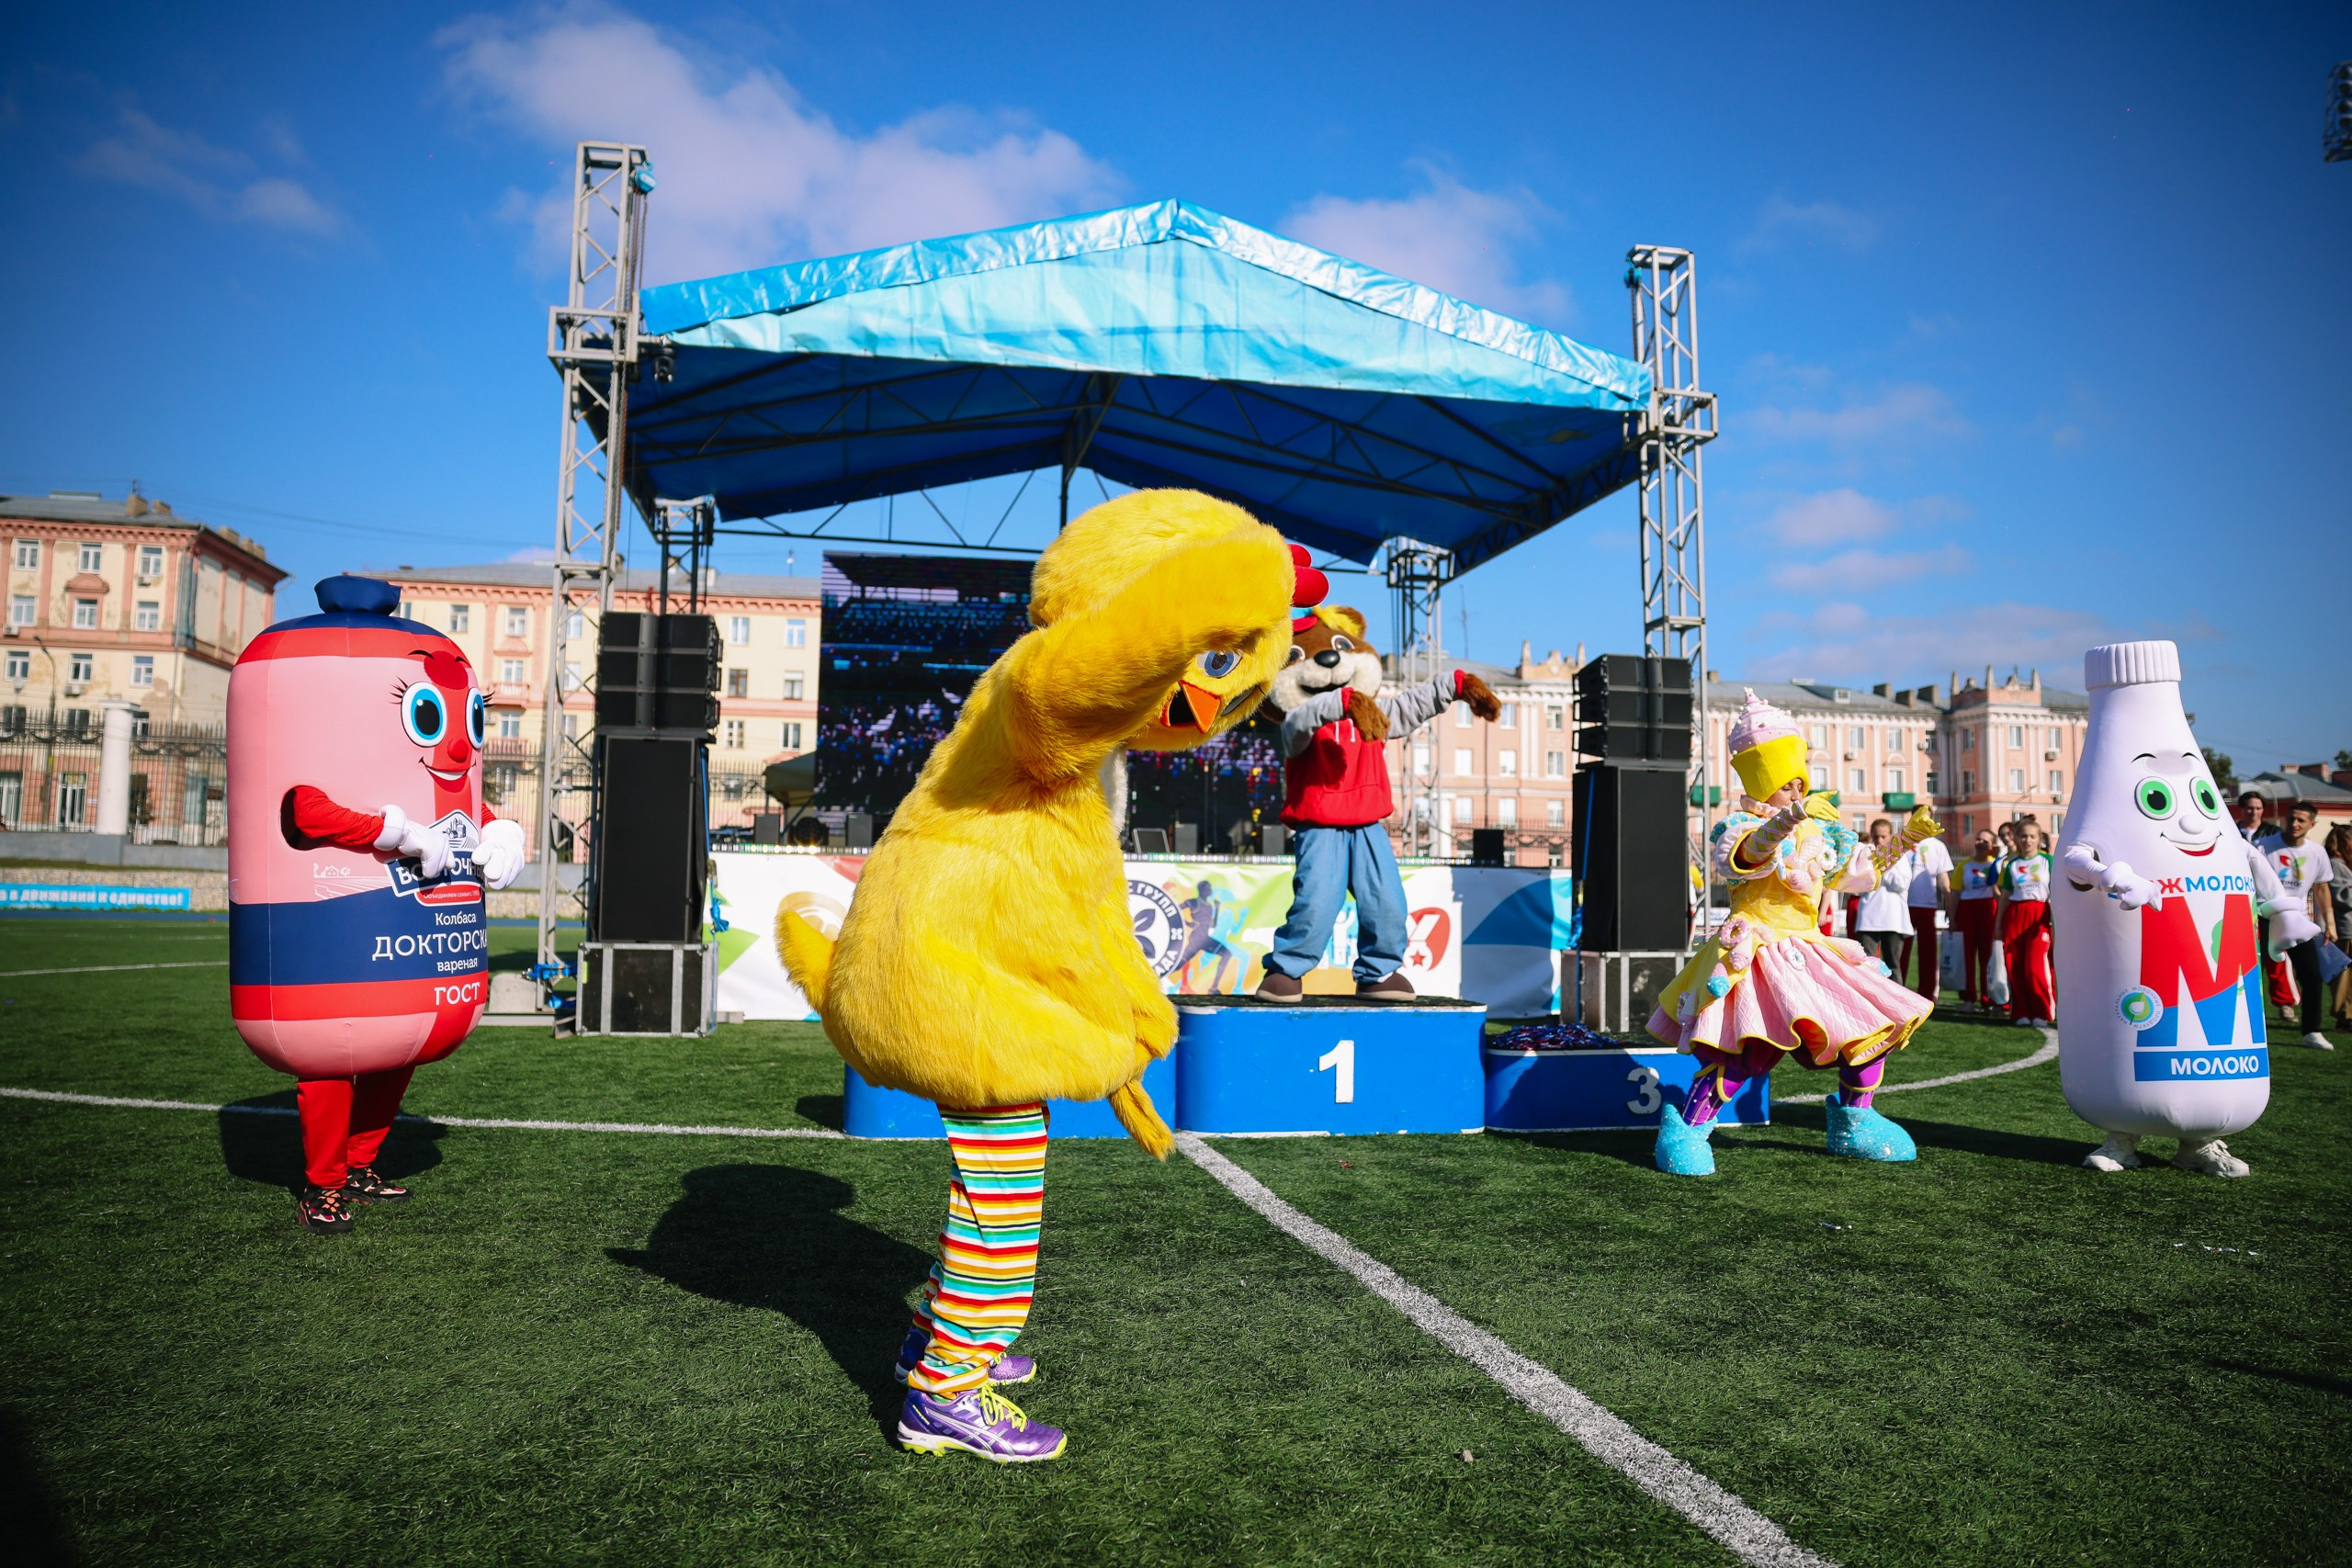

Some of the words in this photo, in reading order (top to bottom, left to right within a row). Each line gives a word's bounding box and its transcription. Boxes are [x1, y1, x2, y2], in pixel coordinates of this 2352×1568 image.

[2150, 875, 2256, 894] ЖМОЛОКО
[1136, 883, 1177, 918] ГРУПП
[435, 911, 477, 926] Колбаса
[436, 957, 478, 974] вареная
[434, 982, 481, 1006] ГОСТ
[1318, 1040, 1355, 1104] 1
[2171, 1055, 2259, 1076] МОЛОКО
[1626, 1066, 1662, 1115] 3
